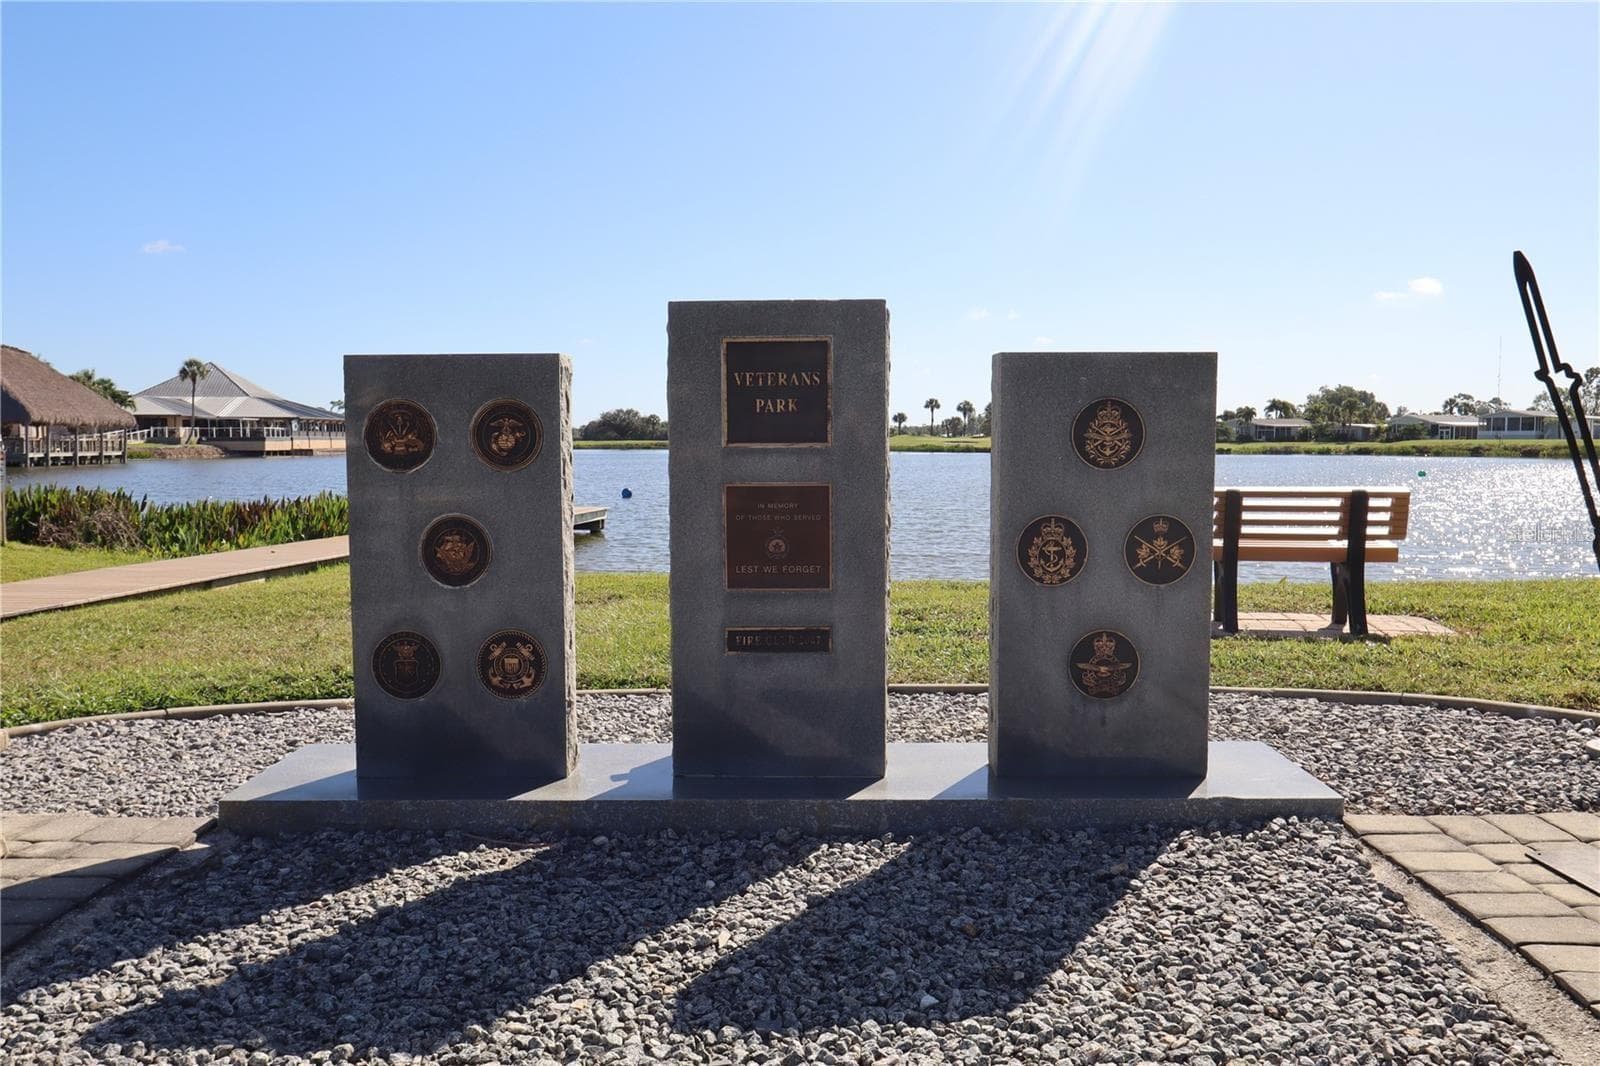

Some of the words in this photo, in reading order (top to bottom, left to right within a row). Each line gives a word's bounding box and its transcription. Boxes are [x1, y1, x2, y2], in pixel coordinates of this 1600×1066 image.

[734, 371, 820, 386] VETERANS
[755, 398, 798, 413] PARK
[767, 502, 799, 510] MEMORY
[735, 513, 745, 521] OF
[747, 513, 772, 521] THOSE
[774, 513, 791, 521] WHO
[793, 513, 822, 521] SERVED
[735, 564, 759, 574] LEST
[762, 564, 778, 574] WE
[781, 564, 822, 574] FORGET
